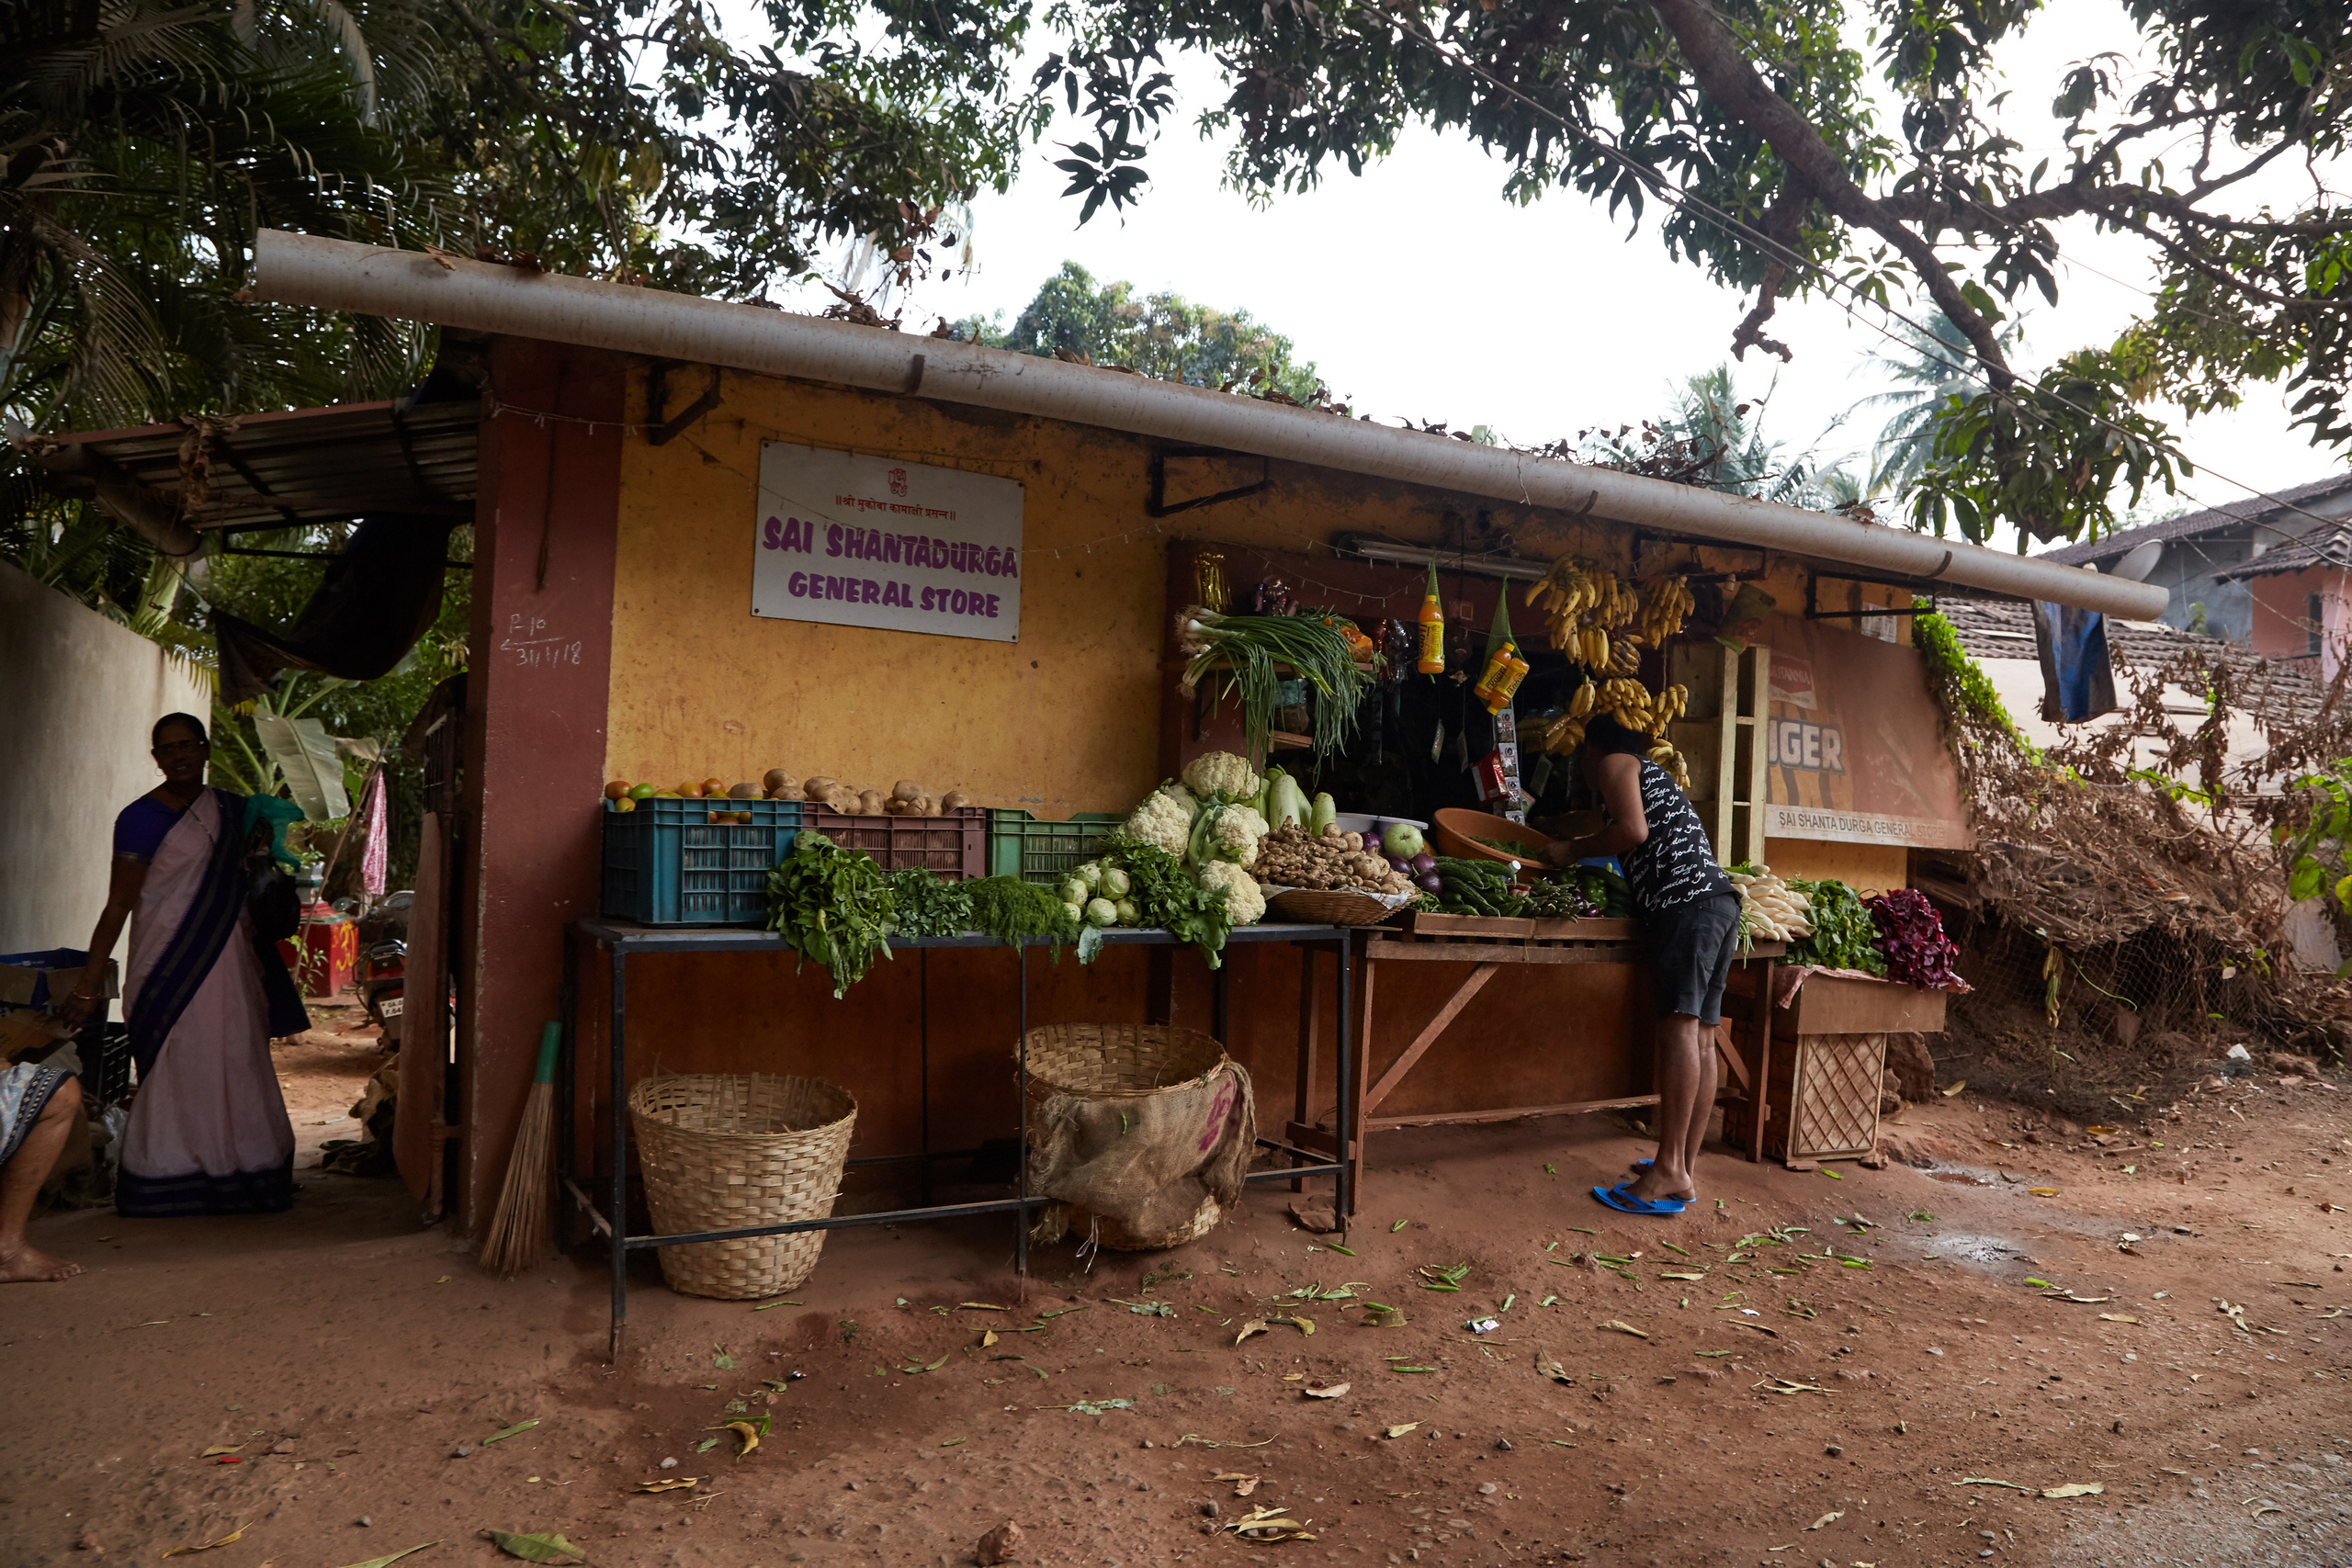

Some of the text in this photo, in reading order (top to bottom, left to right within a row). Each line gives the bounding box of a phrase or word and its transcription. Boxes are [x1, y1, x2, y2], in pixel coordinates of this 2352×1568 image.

[762, 515, 1018, 579] SAI SHANTADURGA
[787, 570, 1001, 618] GENERAL STORE
[1769, 718, 1845, 772] IGER
[1779, 811, 1945, 840] SAI SHANTA DURGA GENERAL STORE
